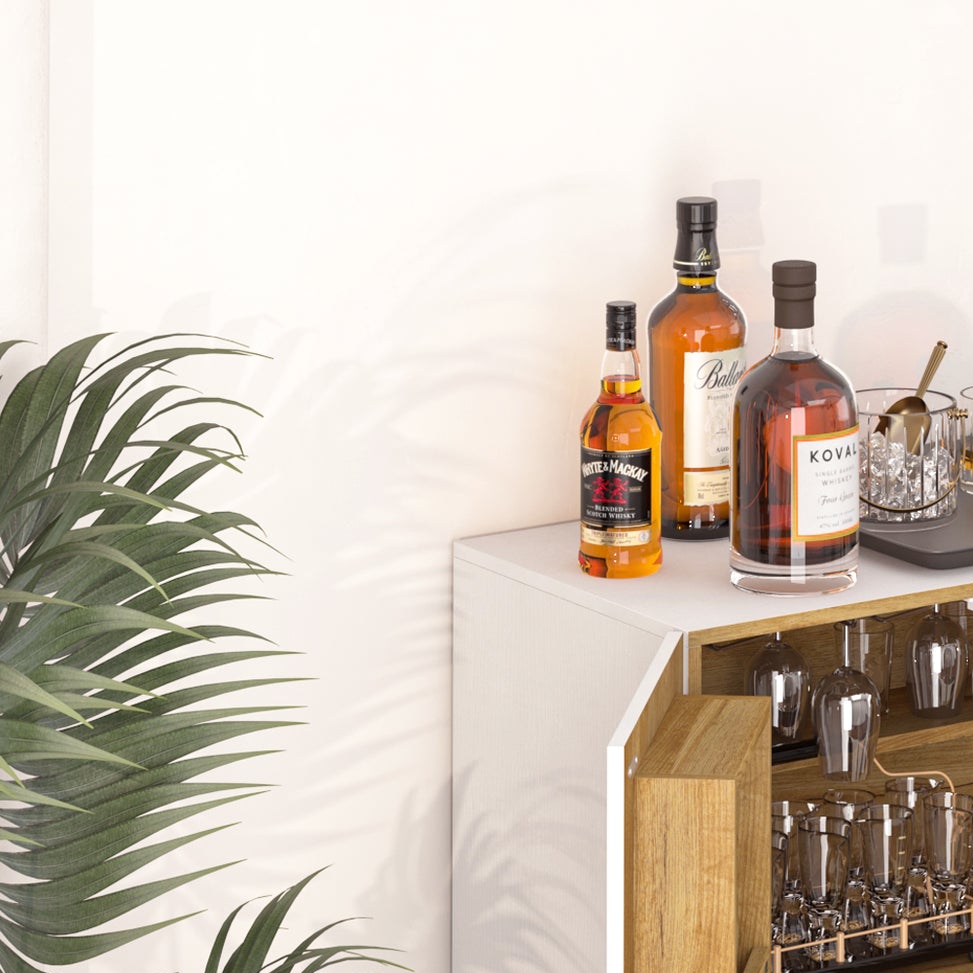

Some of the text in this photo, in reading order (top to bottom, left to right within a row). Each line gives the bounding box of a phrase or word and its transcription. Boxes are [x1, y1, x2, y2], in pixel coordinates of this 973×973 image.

[810, 442, 857, 463] KOVAL
[582, 461, 604, 477] WHYTE
[609, 459, 649, 482] MACKAY
[586, 509, 607, 518] SCOTCH
[594, 504, 624, 512] BLENDED
